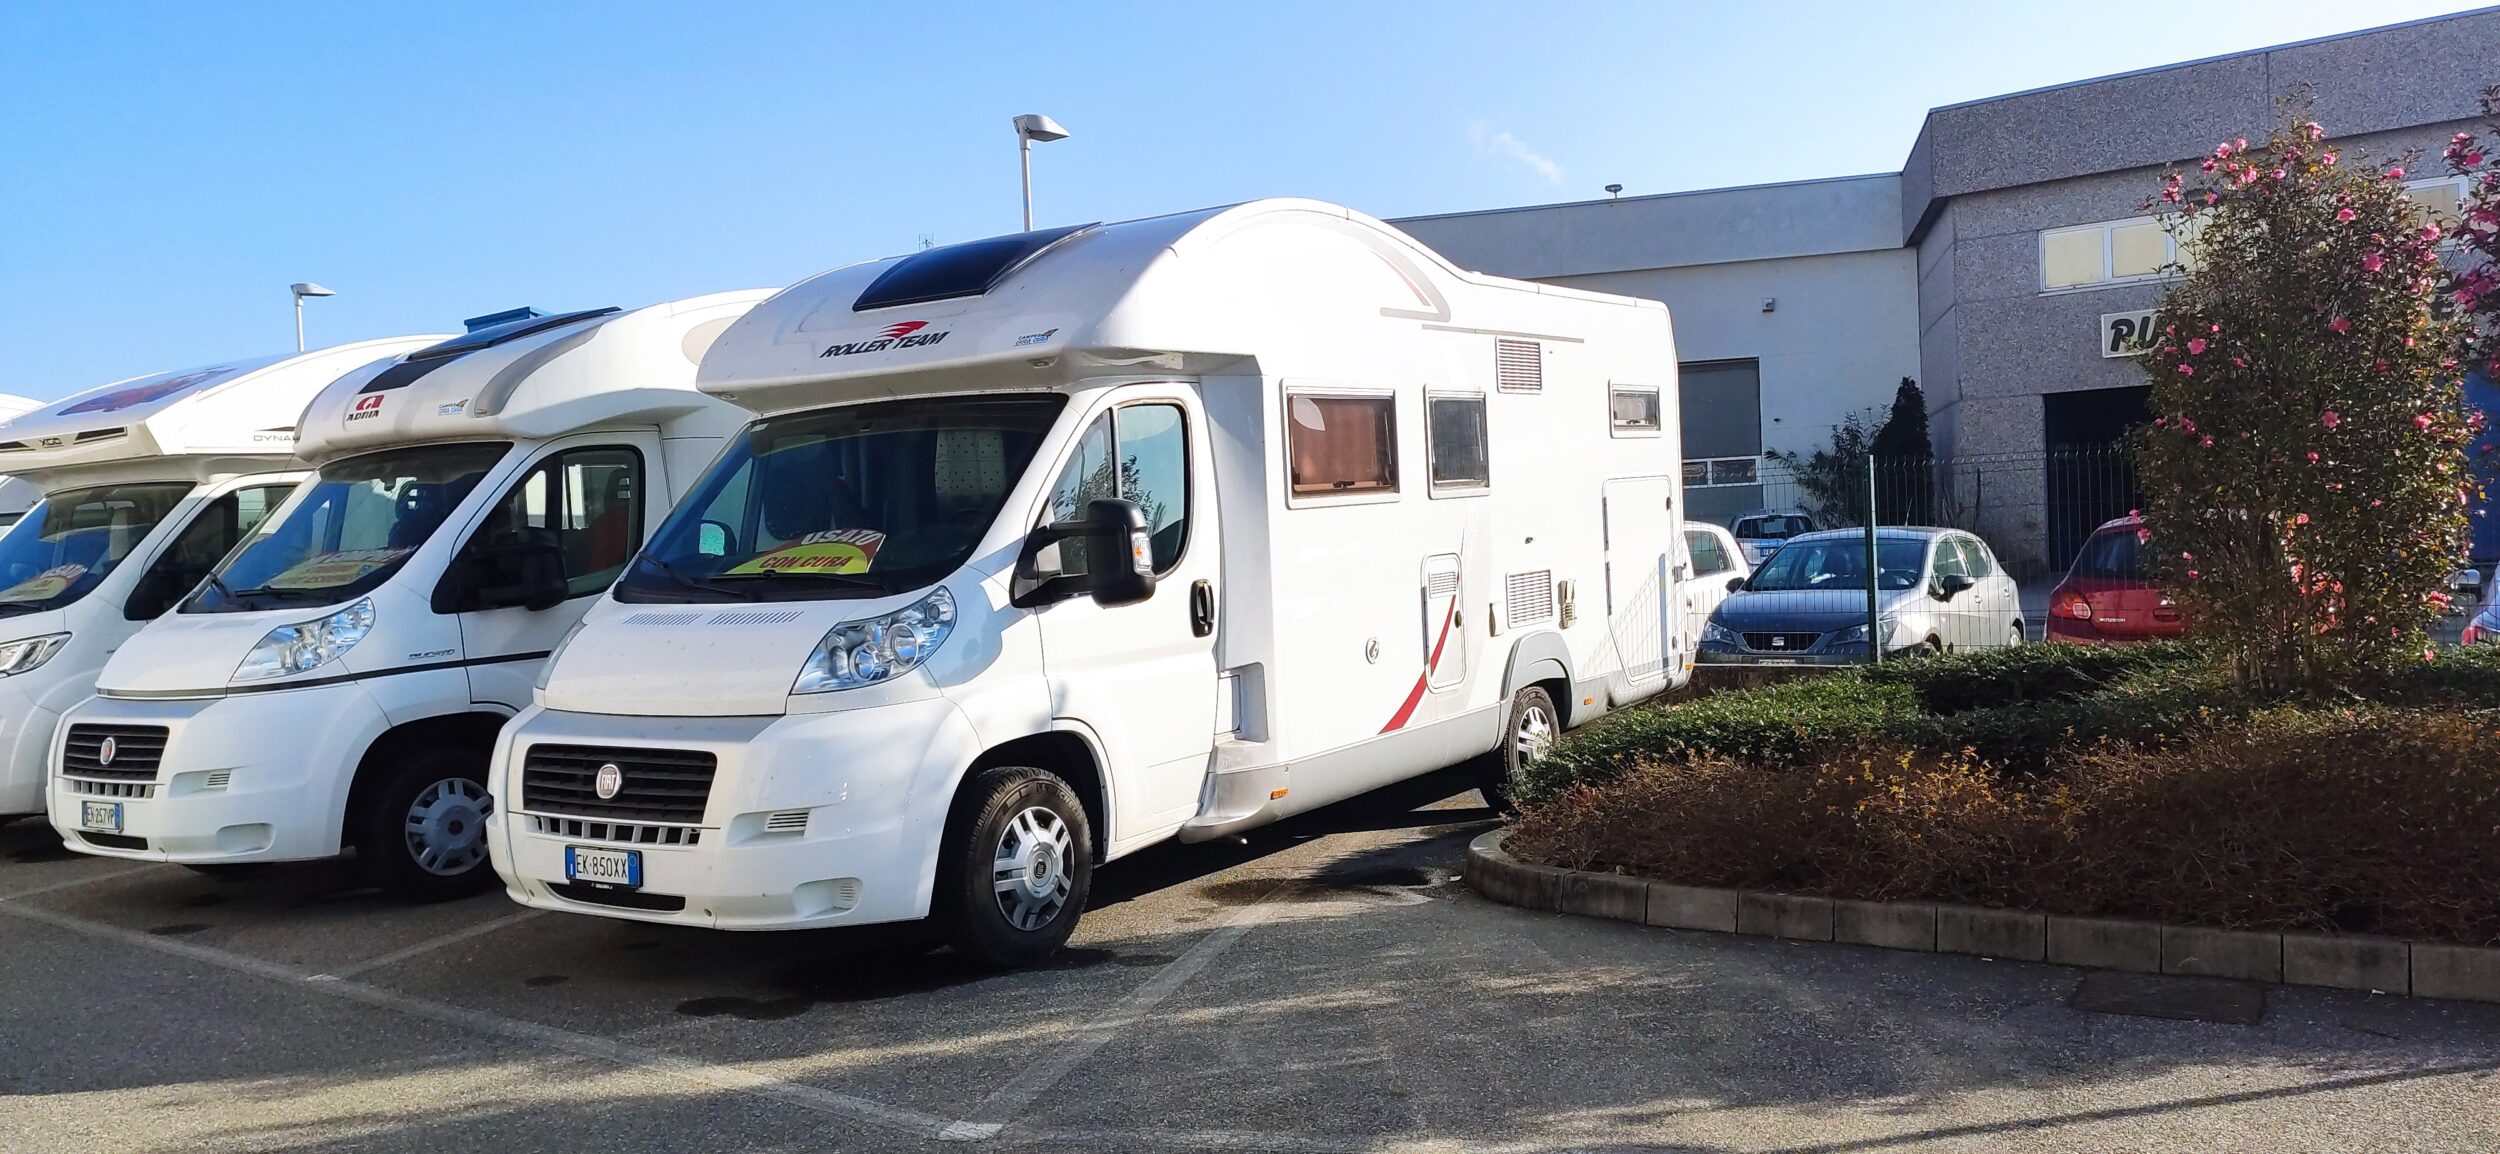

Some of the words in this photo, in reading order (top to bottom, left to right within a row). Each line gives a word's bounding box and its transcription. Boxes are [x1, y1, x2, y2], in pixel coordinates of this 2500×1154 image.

[819, 339, 895, 358] ROLLER
[892, 331, 950, 349] TEAM
[346, 410, 380, 421] ADRIA
[801, 529, 882, 546] USATO
[759, 556, 801, 569] CON
[799, 556, 854, 568] CURA
[576, 854, 589, 875] EK
[592, 856, 628, 879] 850XX
